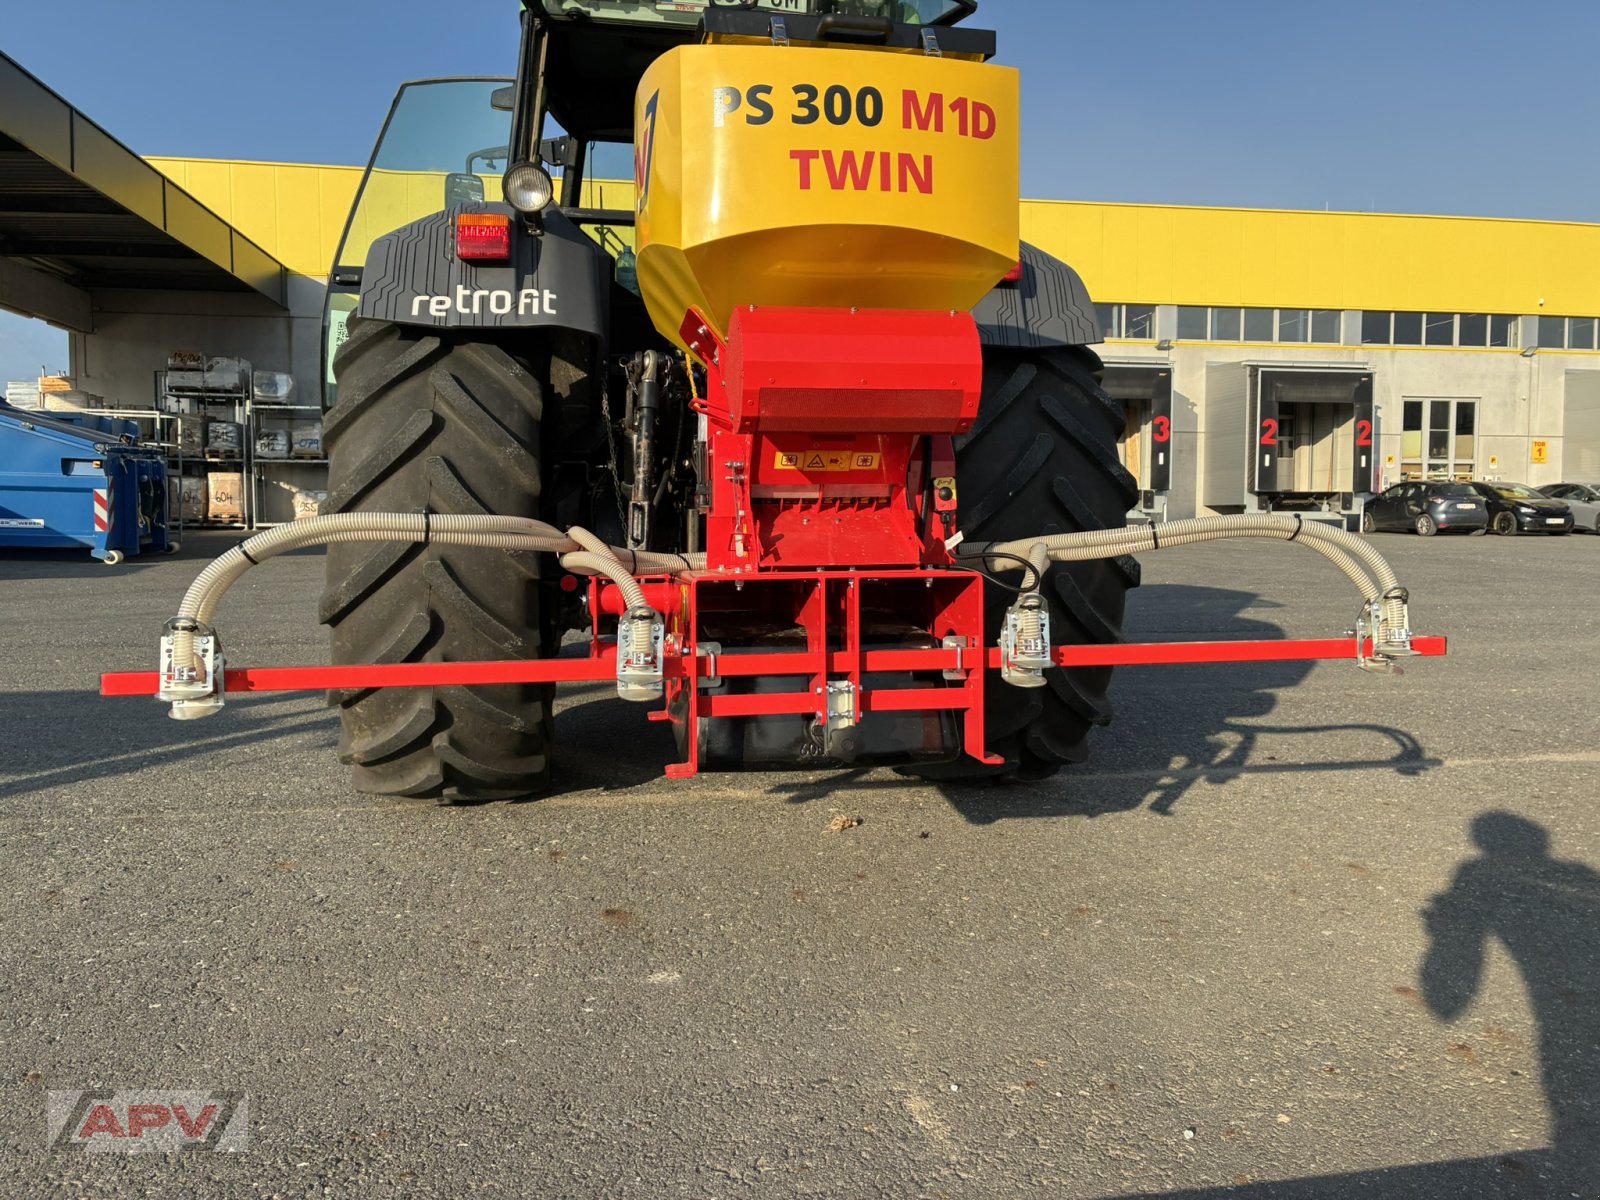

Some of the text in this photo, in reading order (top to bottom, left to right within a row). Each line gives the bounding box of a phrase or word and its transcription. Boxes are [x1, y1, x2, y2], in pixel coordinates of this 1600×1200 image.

[713, 84, 773, 128] PS
[791, 84, 883, 127] 300
[789, 149, 933, 194] TWIN
[411, 284, 558, 316] retrofit
[1153, 415, 1170, 442] 3
[1260, 418, 1279, 446] 2
[1355, 419, 1372, 446] 2
[1536, 447, 1542, 457] 1
[215, 490, 233, 505] 604
